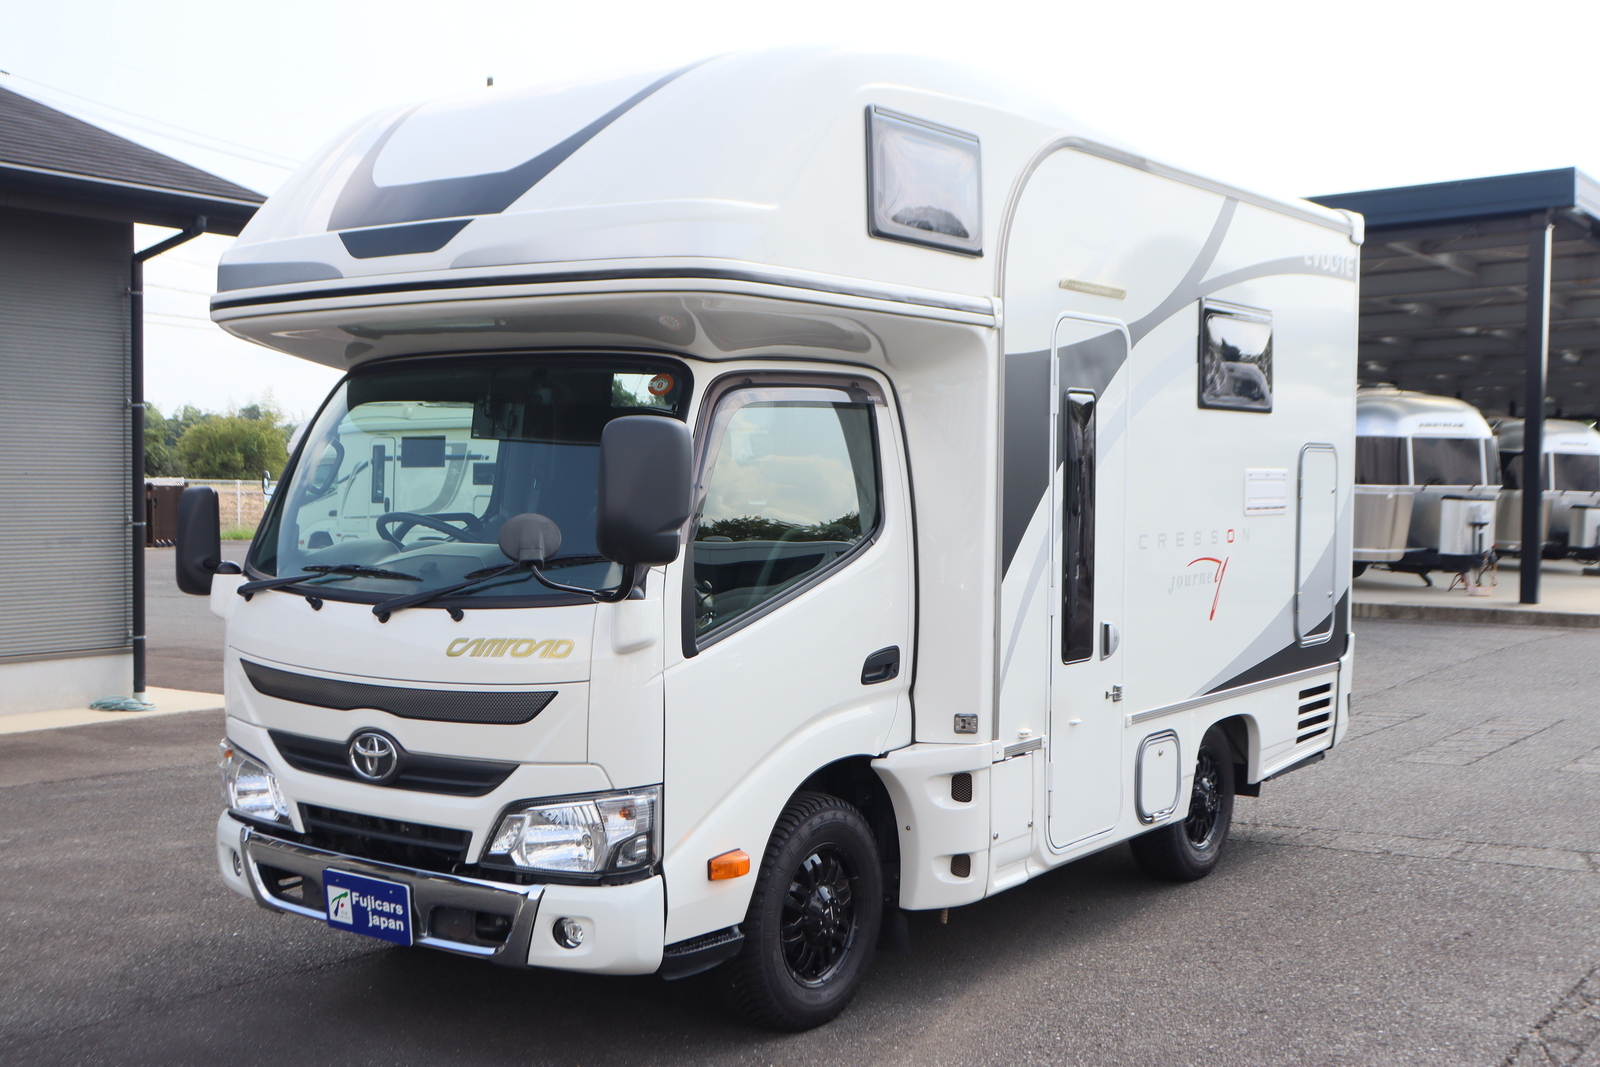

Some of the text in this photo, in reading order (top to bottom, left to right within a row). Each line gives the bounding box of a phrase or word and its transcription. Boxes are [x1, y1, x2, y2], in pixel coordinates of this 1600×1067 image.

[1138, 528, 1251, 550] CRESSON
[351, 891, 404, 916] Fujicars
[367, 911, 404, 932] japan
